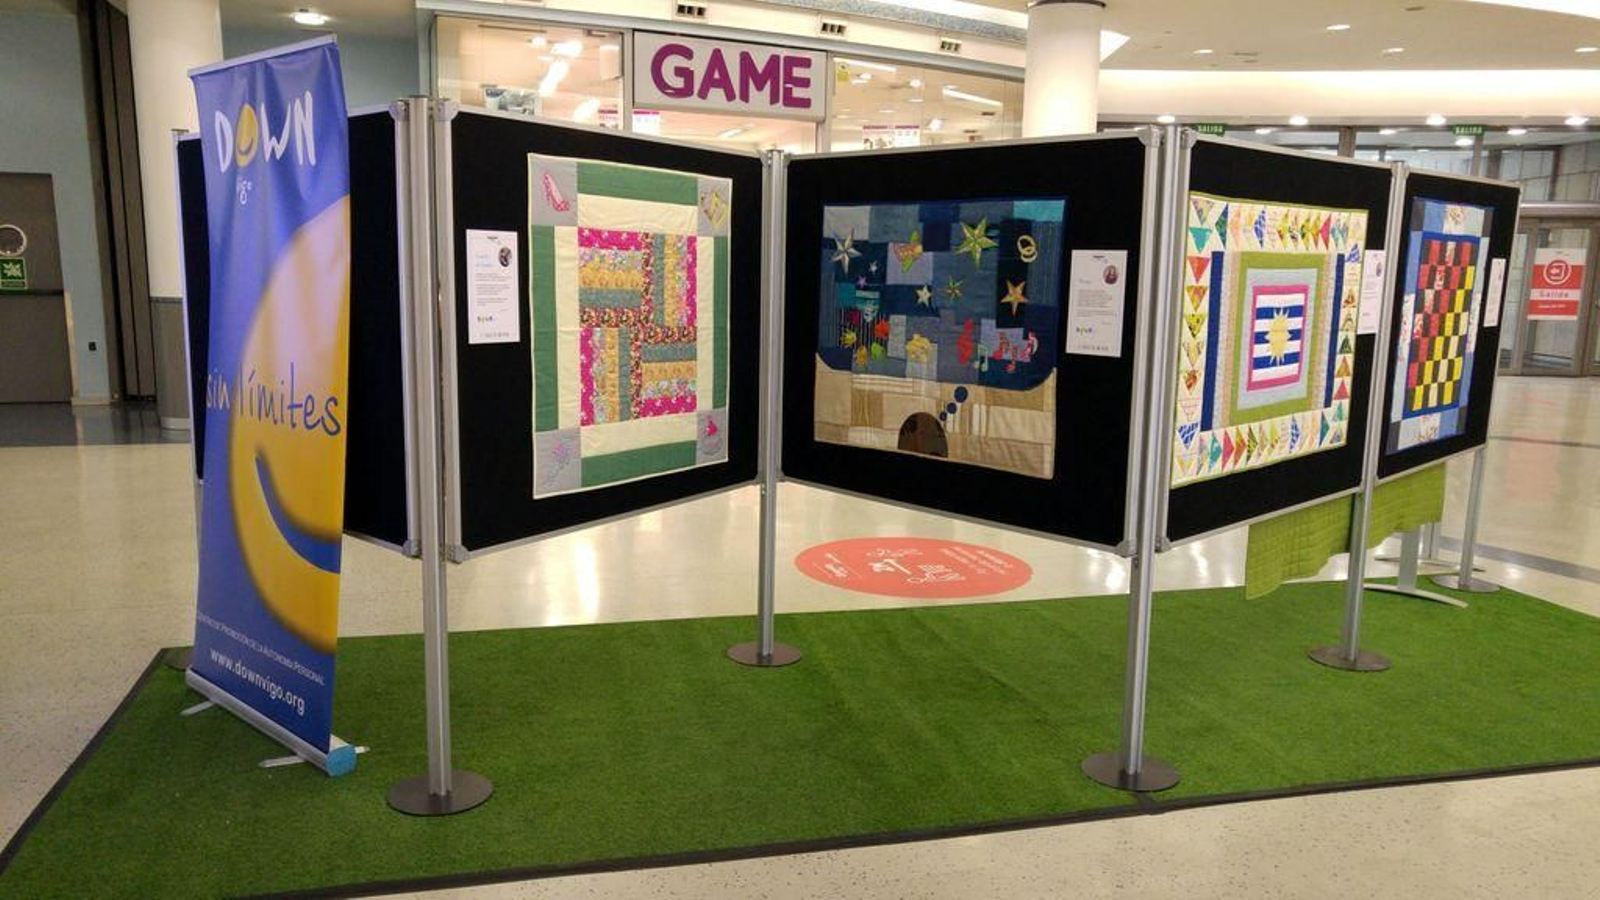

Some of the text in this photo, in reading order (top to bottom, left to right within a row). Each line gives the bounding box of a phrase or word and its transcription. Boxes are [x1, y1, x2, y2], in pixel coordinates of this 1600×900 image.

[651, 44, 812, 109] GAME
[214, 90, 317, 174] DOWN
[1197, 124, 1224, 134] SALIDA
[1455, 125, 1482, 135] SALIDA
[206, 361, 342, 437] sin límites
[210, 647, 306, 717] www.downvigo.org
